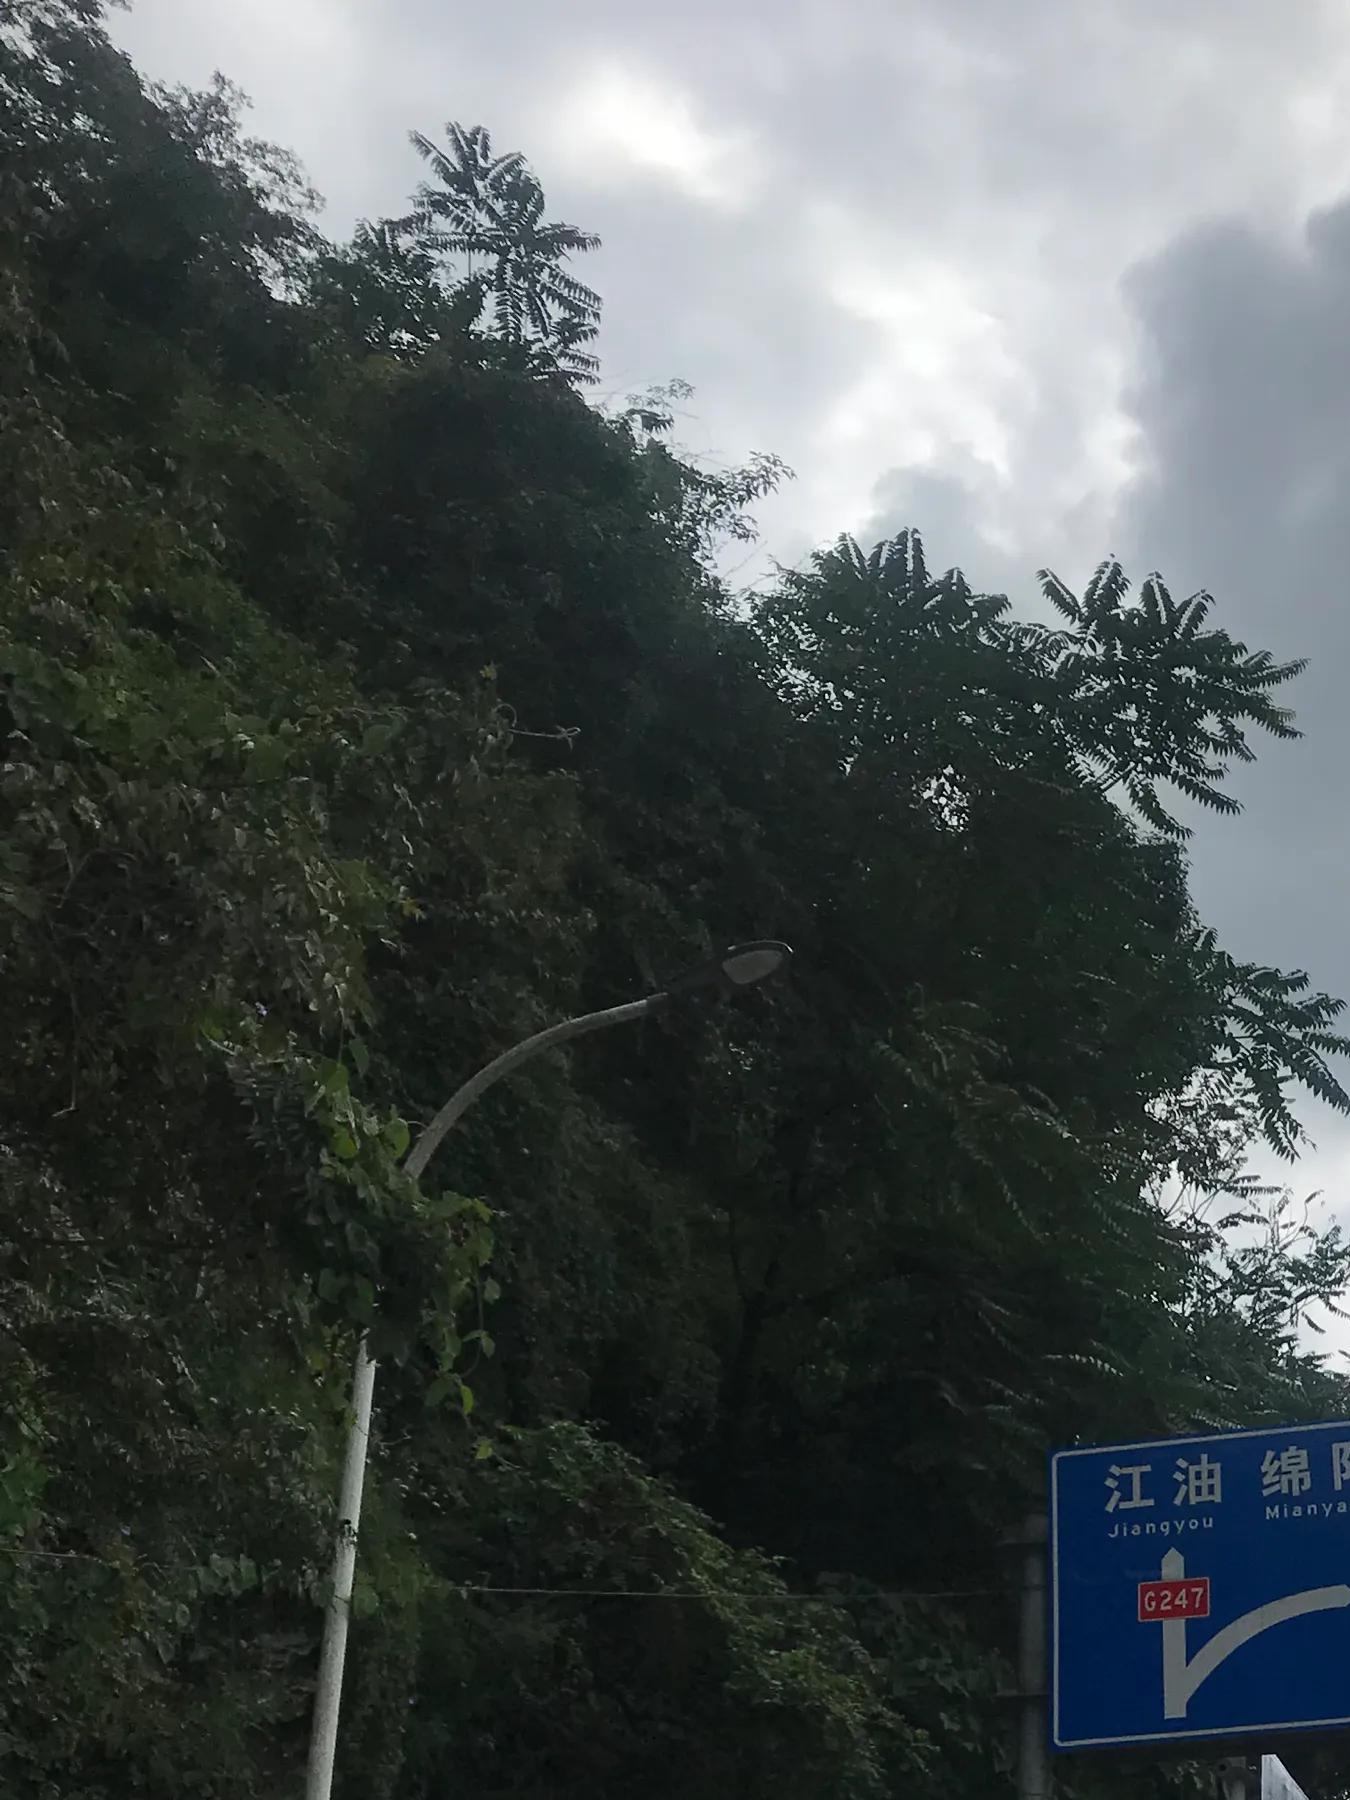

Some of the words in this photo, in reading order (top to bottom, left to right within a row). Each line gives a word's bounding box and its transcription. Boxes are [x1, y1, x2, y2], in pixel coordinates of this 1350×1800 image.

[1104, 1454, 1222, 1512] 江油
[1107, 1515, 1214, 1539] Jiangyou
[1144, 1586, 1205, 1612] G247
